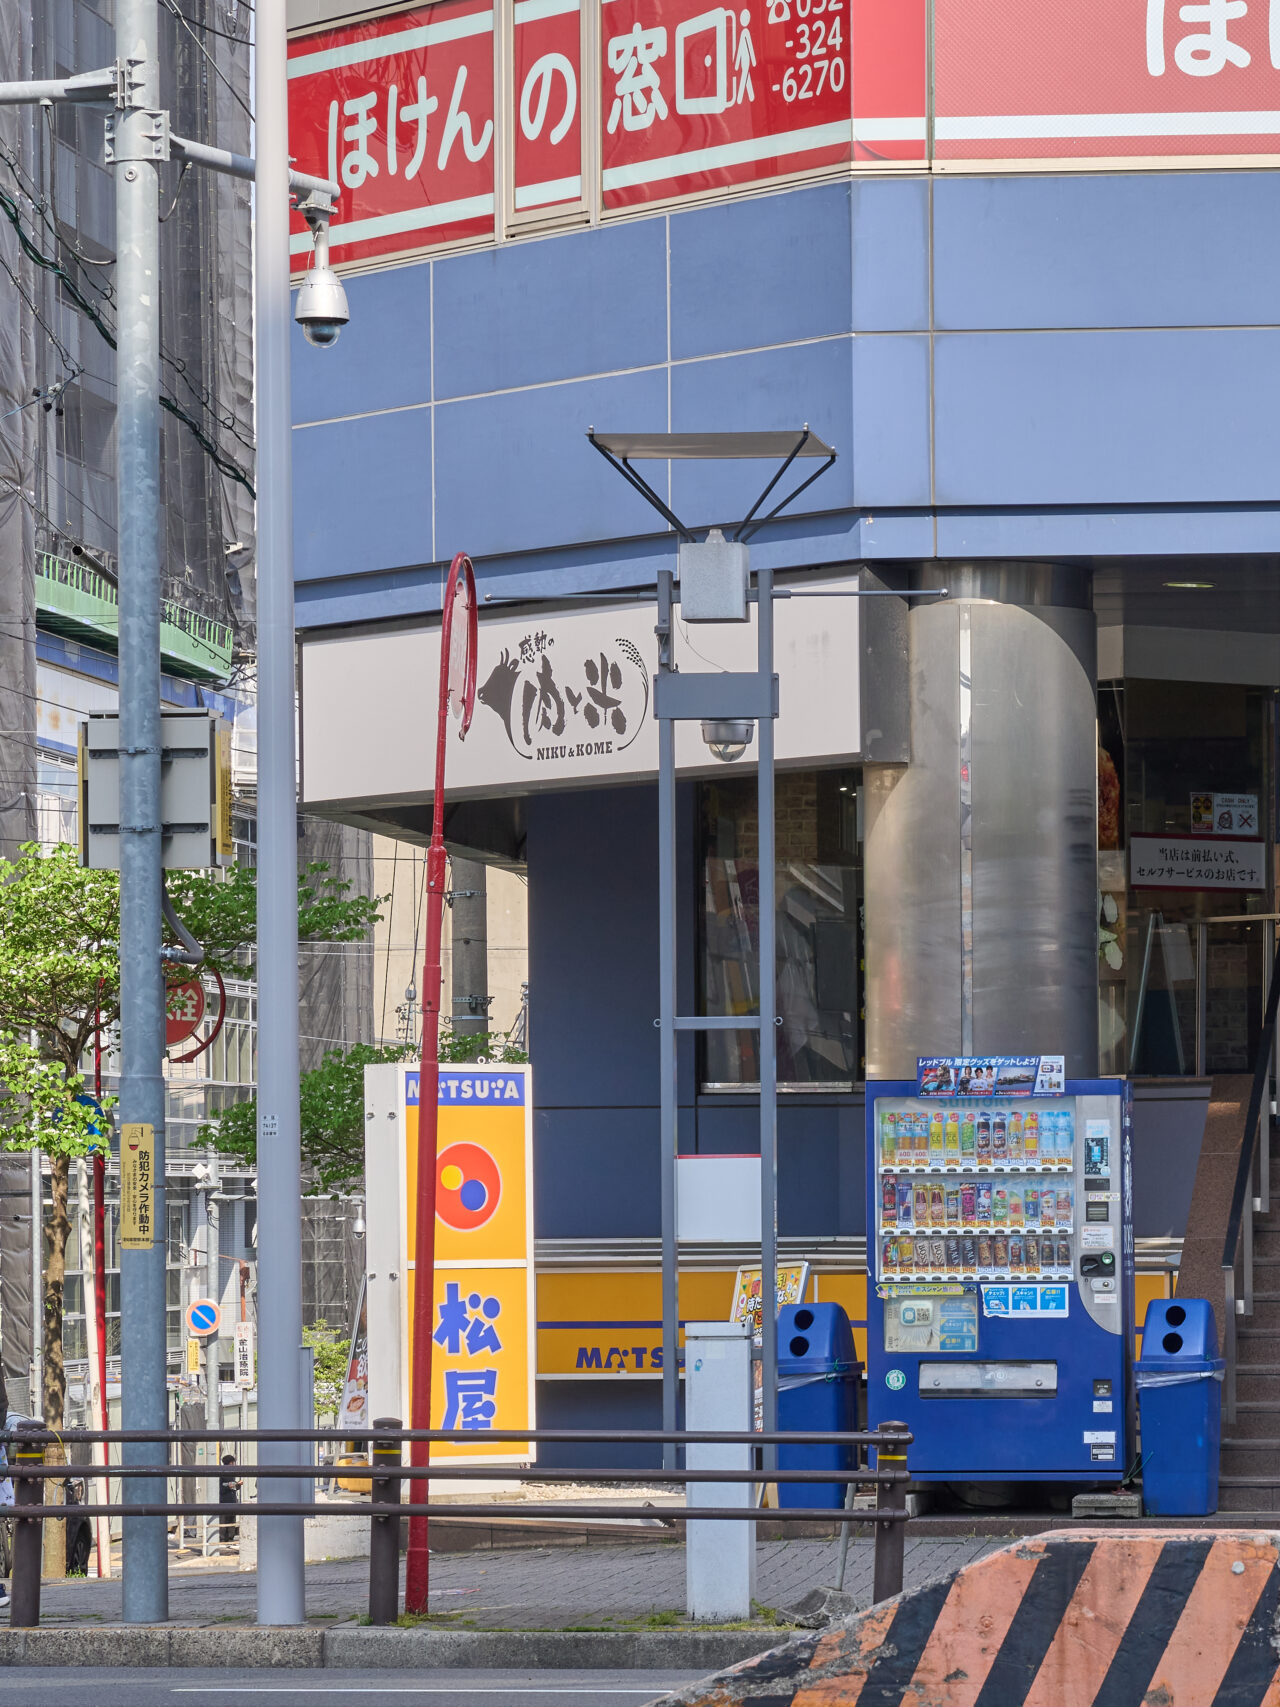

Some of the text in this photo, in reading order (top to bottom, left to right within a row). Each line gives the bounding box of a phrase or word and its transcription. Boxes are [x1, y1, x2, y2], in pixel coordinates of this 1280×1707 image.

[771, 56, 845, 102] -6270
[1158, 847, 1240, 864] 当店は前払い式、
[1136, 866, 1260, 883] セルフサービスのお店です。
[138, 1150, 150, 1235] 防犯カメラ作動中
[433, 1282, 503, 1444] 松屋
[576, 1346, 686, 1369] MATS
